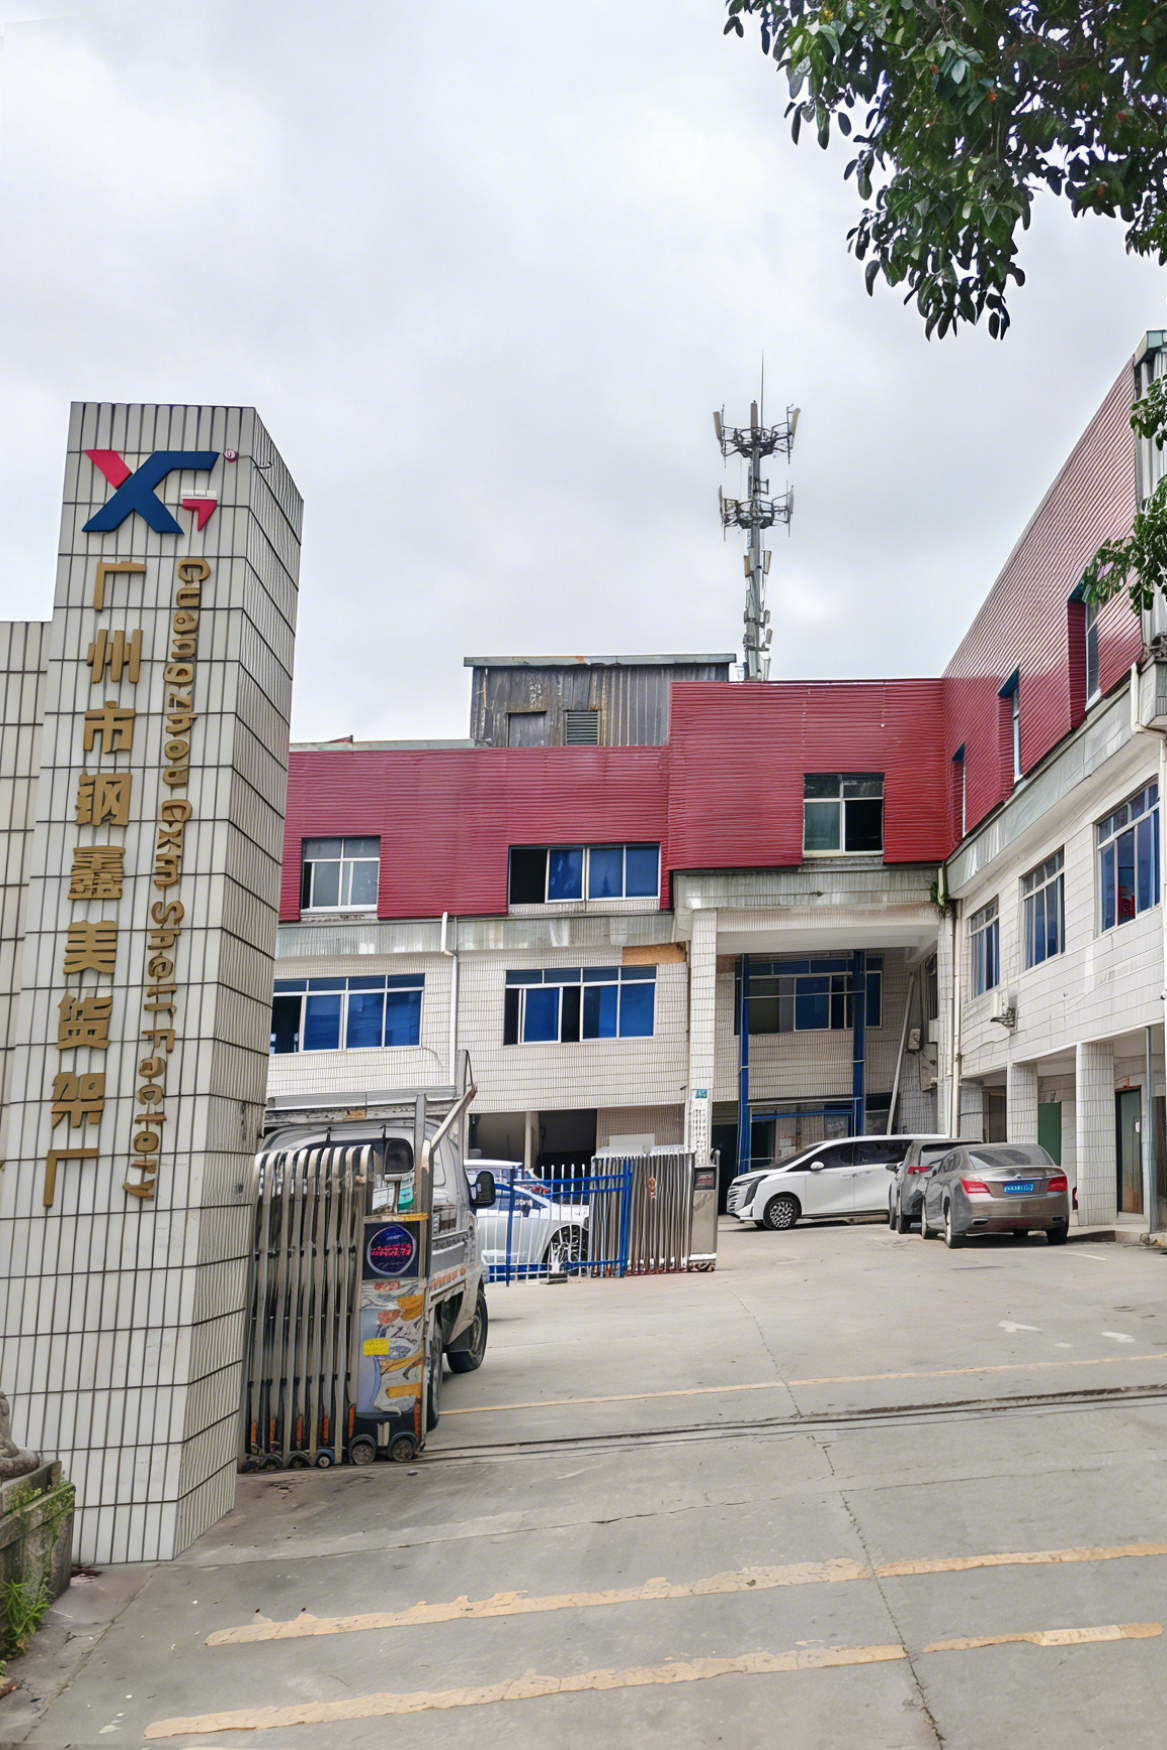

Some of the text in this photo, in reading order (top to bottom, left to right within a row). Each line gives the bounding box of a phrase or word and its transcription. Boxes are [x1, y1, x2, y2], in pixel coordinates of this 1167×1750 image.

[163, 558, 210, 788] Guangzhou
[43, 560, 147, 1207] 广州市钢鑫美货架厂
[123, 1028, 176, 1200] Factory
